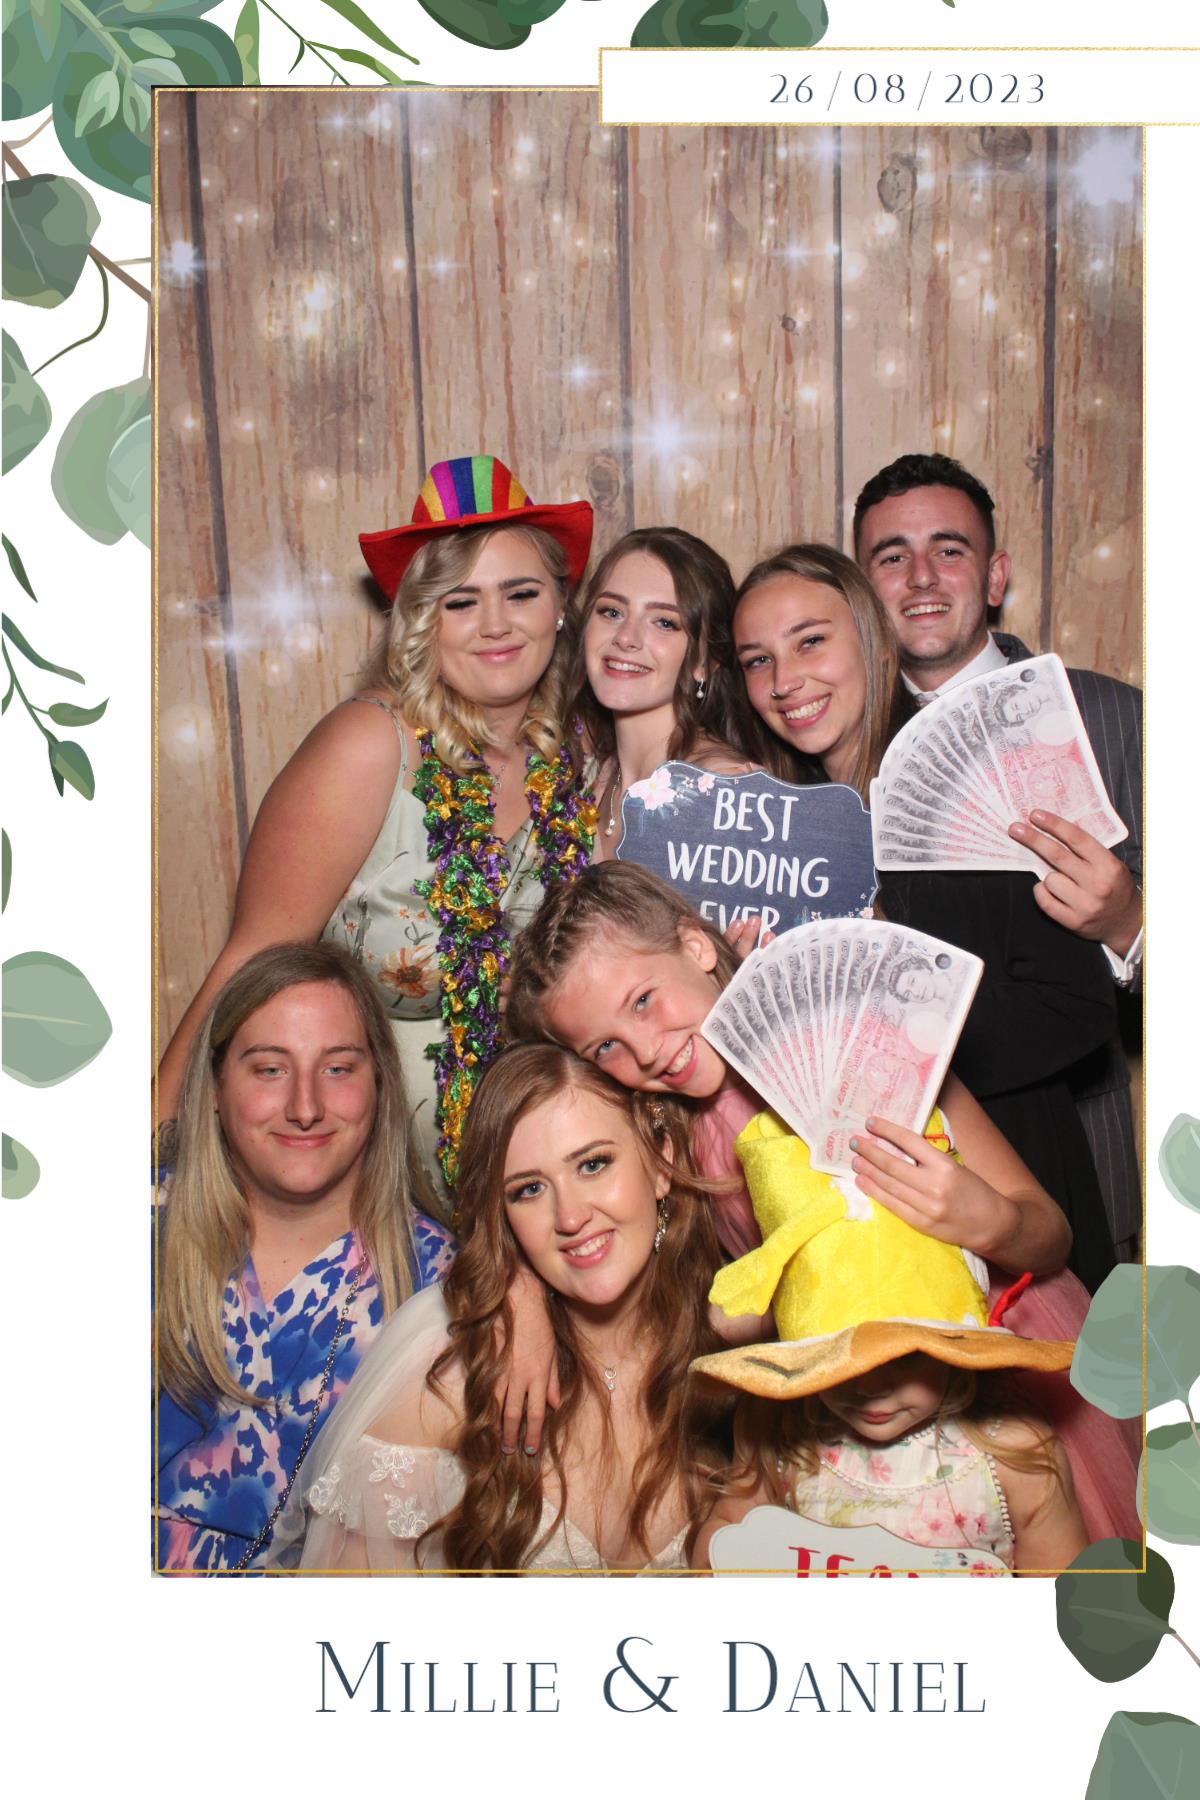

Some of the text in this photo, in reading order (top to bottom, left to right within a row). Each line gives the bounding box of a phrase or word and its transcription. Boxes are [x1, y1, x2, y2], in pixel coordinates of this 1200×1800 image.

[713, 787, 799, 843] BEST
[667, 840, 829, 898] WEDDING
[788, 1546, 920, 1578] TE
